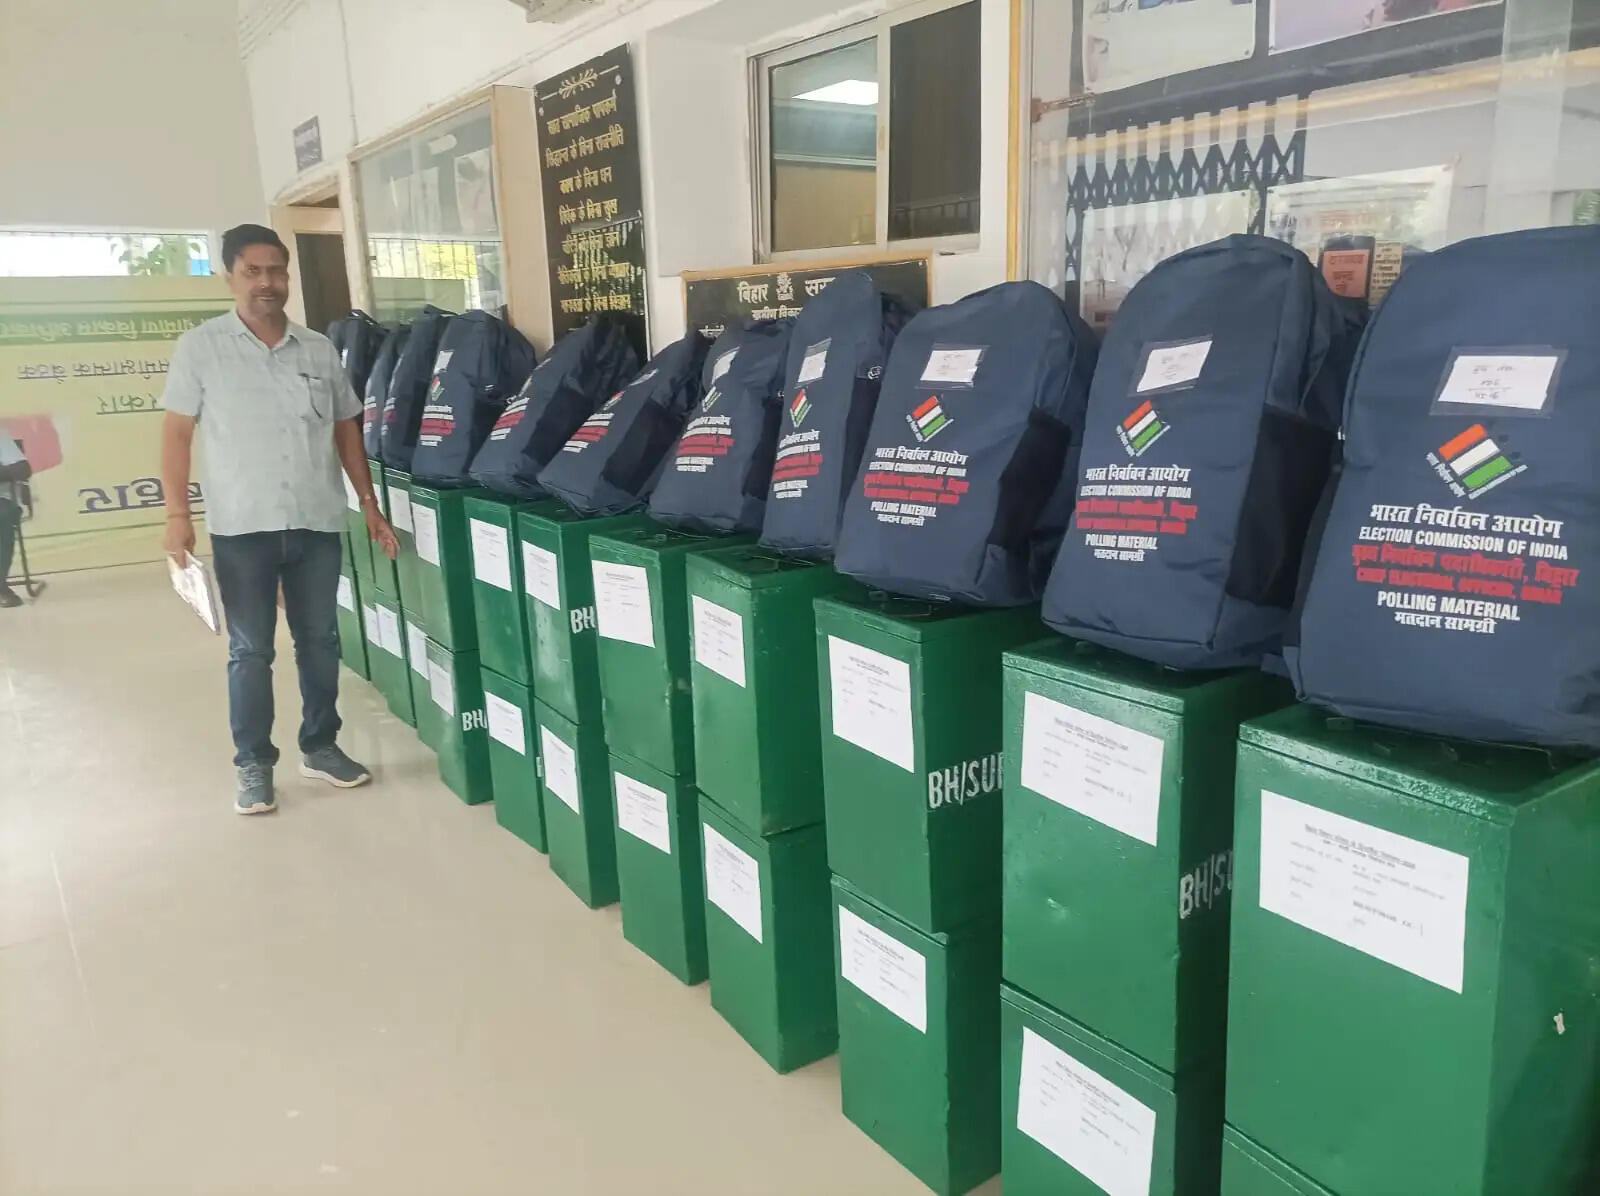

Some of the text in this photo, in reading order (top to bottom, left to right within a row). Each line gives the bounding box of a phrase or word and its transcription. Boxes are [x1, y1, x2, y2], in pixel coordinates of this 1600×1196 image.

[737, 281, 768, 304] बिहार
[931, 450, 968, 465] आयोग
[1108, 464, 1147, 480] निर्वाचन
[1148, 464, 1191, 481] आयोग
[1154, 486, 1167, 497] OF
[1370, 503, 1564, 538] भारत निर्वाचन आयोग
[1359, 526, 1568, 560] ELECTION COMMISSION OF INDIA
[1377, 590, 1520, 621] POLLING MATERIAL
[1395, 611, 1497, 633] मतदान सामग्री
